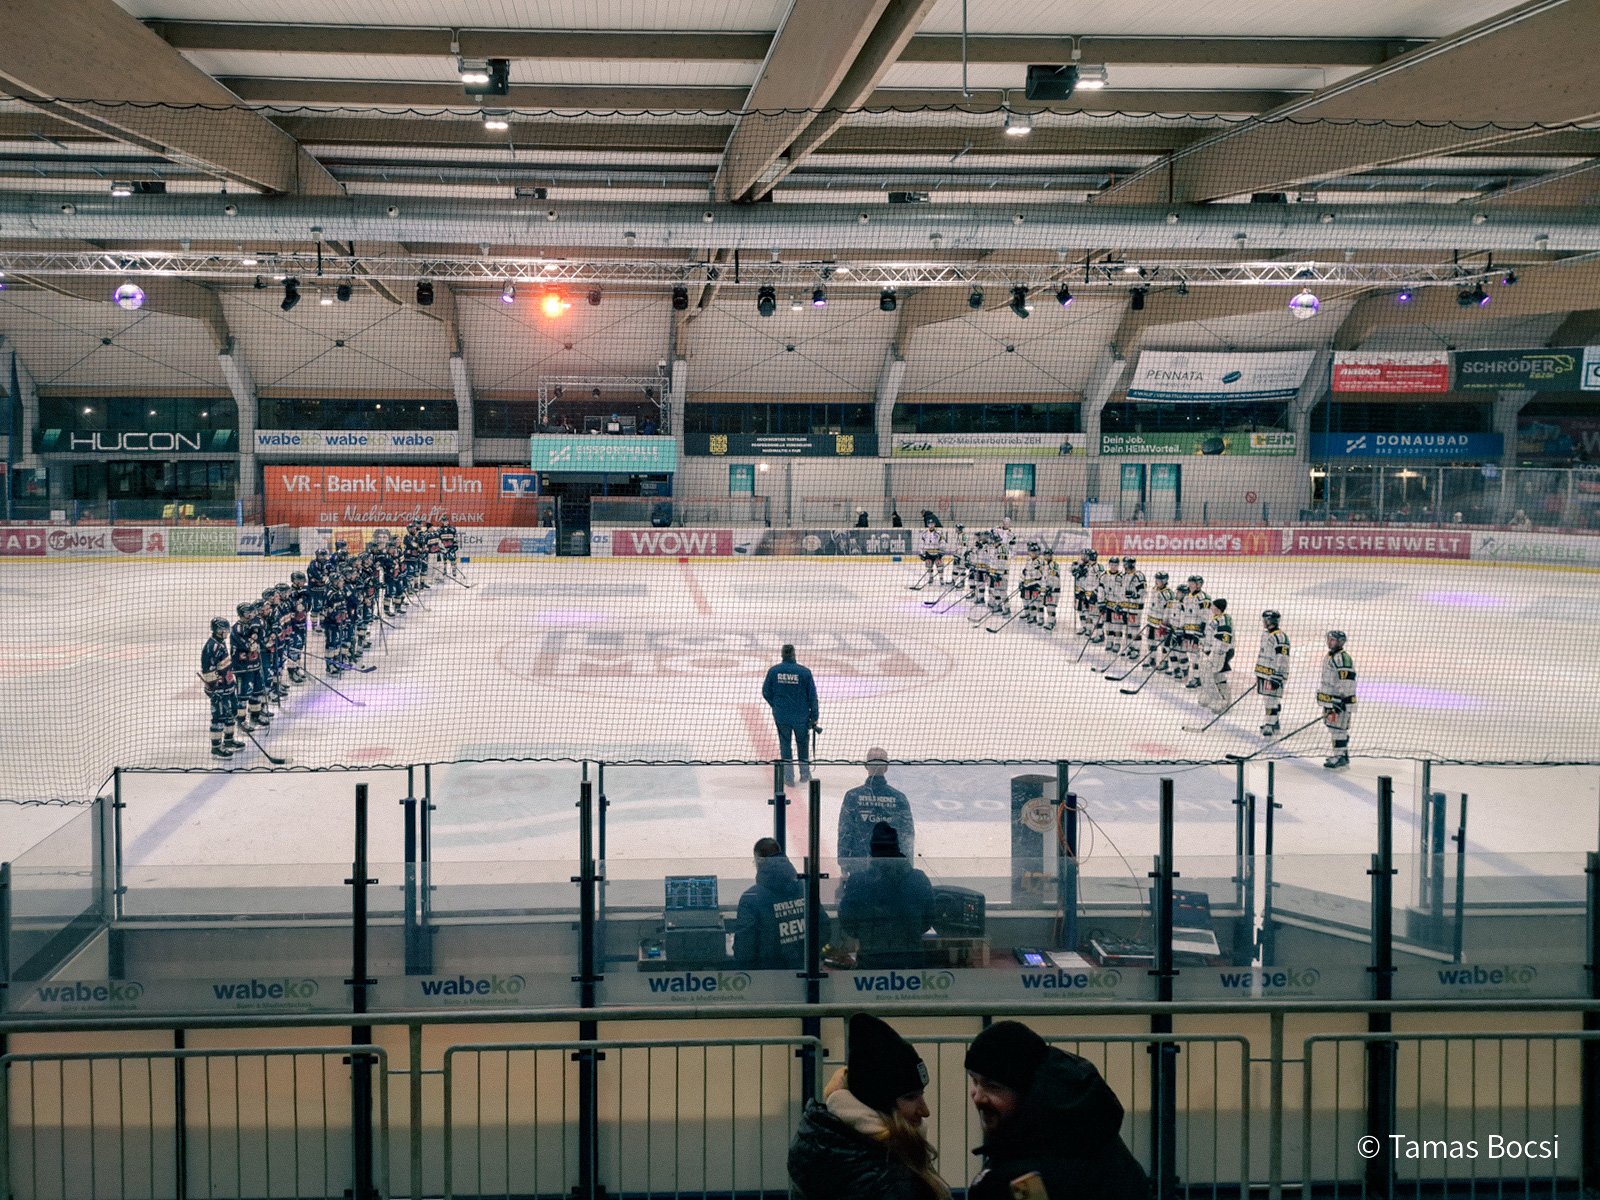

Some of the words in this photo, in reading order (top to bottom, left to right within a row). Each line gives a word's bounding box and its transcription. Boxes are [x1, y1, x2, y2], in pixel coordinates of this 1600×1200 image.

[1462, 357, 1554, 373] SCHRÖDER
[1146, 370, 1204, 381] PENNATA
[71, 432, 200, 450] HUCON
[1103, 435, 1123, 444] Dein
[1126, 435, 1145, 444] Job.
[1376, 435, 1469, 445] DONAUBAD
[1103, 445, 1123, 453] Dein
[1126, 445, 1181, 453] HEIMVorteil.
[320, 512, 339, 522] DIE
[452, 512, 484, 522] BANK
[631, 532, 718, 553] WOW!
[1123, 534, 1241, 550] McDonald's
[1299, 535, 1461, 553] RUTSCHENWELT
[777, 673, 799, 682] REWE
[648, 972, 750, 992] wabeko
[854, 971, 953, 991] wabeko
[1021, 969, 1121, 988] wabeko
[1439, 965, 1535, 984] wabeko
[37, 981, 143, 1001] wabeko
[213, 979, 317, 999] wabeko
[421, 975, 526, 995] wabeko
